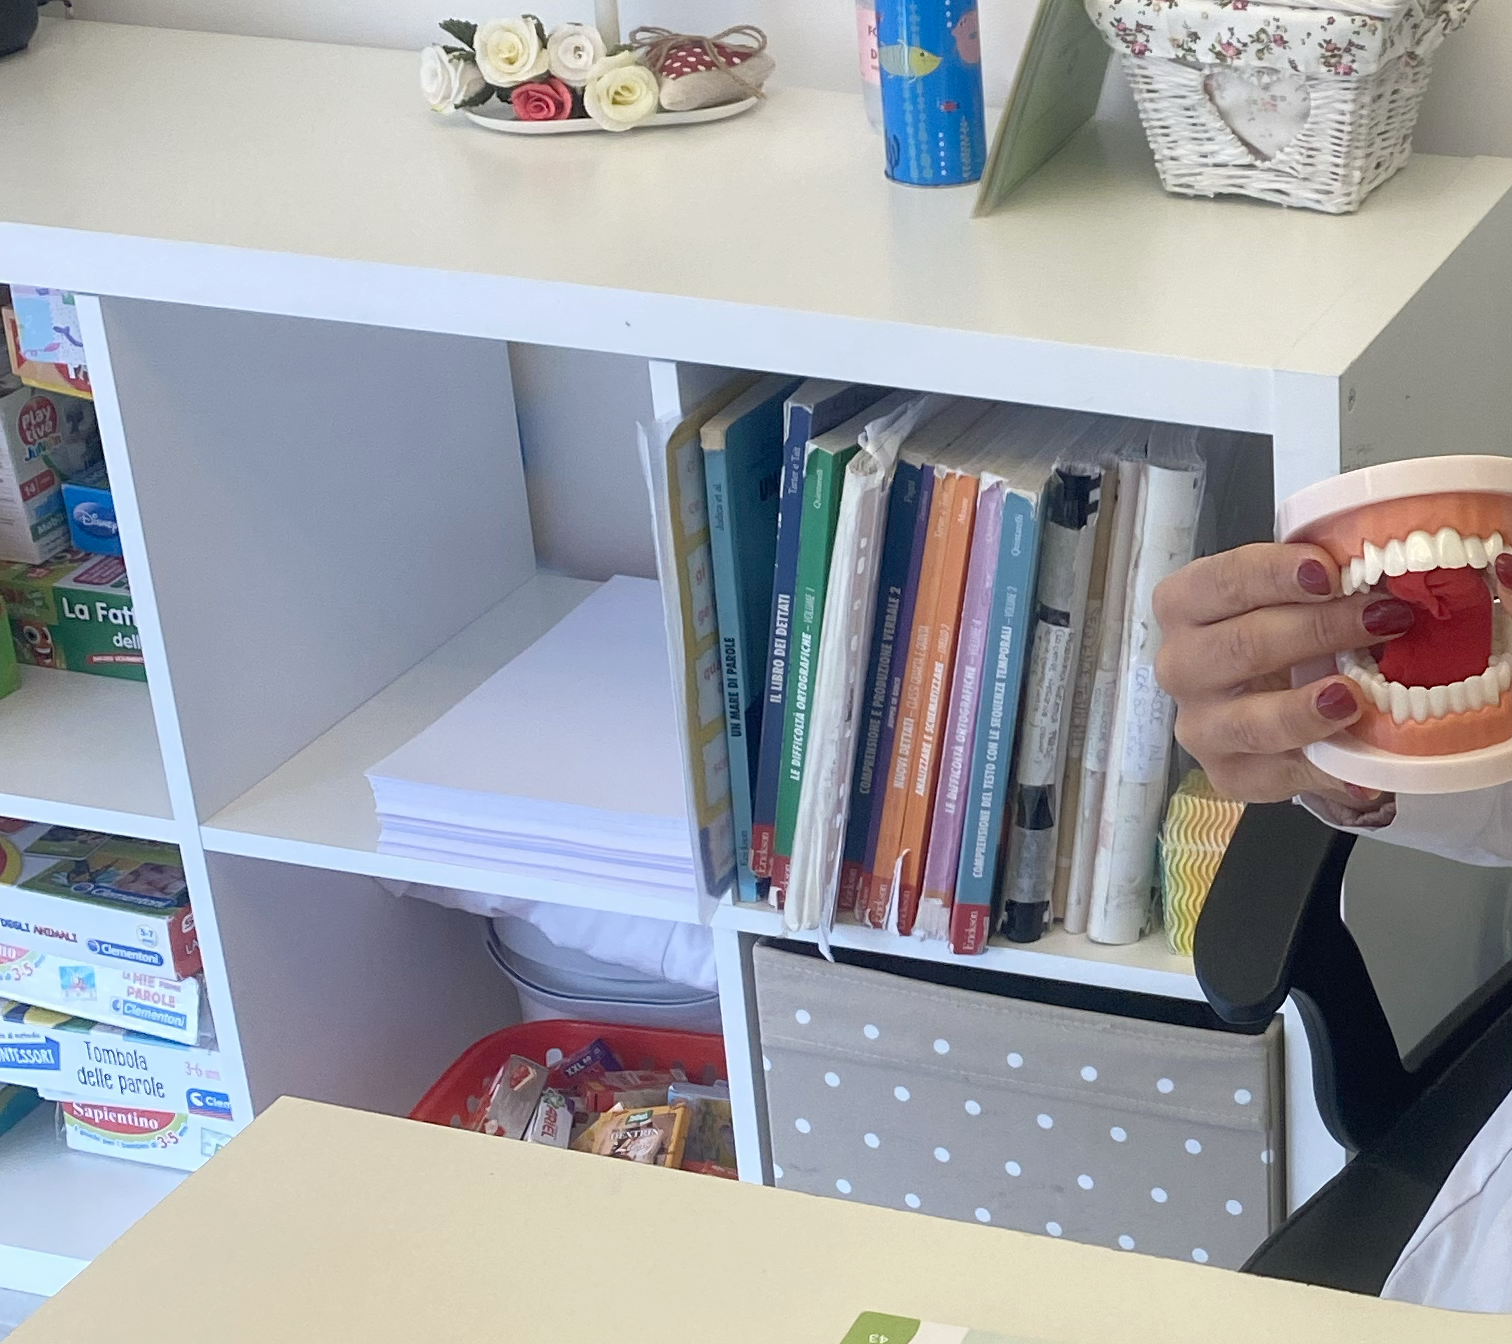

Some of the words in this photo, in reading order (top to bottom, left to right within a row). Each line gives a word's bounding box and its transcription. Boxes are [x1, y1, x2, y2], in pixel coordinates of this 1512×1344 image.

[22, 406, 51, 430] Play
[26, 420, 53, 445] tive
[889, 585, 901, 594] 2
[62, 597, 90, 621] La
[775, 593, 790, 636] DETTATI
[803, 593, 815, 623] VOLUME
[1003, 591, 1016, 617] VOLUME
[882, 596, 899, 641] VERBALE
[723, 637, 737, 675] PAROLE
[773, 638, 787, 656] DEI
[995, 625, 1012, 678] TEMPORALI
[726, 677, 738, 688] DI
[770, 658, 785, 690] LIBRO
[794, 631, 813, 709] ORTOGRAFICHE
[872, 643, 892, 707] PRODUZIONE
[727, 691, 740, 719] MARE
[769, 691, 782, 702] IL
[954, 664, 975, 743] ORTOGRAFICHE
[989, 681, 1006, 727] SEQUENZE
[729, 721, 741, 736] UN
[787, 712, 805, 766] DIFFICOLTÀ
[898, 716, 914, 755] DETTATI
[914, 741, 932, 796] ANALIZZARE
[924, 660, 945, 733] SCHEMATIZZARE
[988, 729, 1000, 740] LE
[859, 718, 881, 794] COMPRENSIONE
[985, 741, 999, 761] CON
[789, 769, 800, 780] LE
[893, 756, 908, 788] NUOVI
[944, 745, 964, 800] DIFFICOLTÀ
[982, 762, 996, 788] TESTO
[944, 801, 956, 813] LE
[980, 790, 993, 807] DEL
[755, 831, 769, 873] Erickson
[971, 809, 991, 878] COMPRENSIONE
[871, 882, 888, 923] Erickson
[897, 888, 911, 923] rickson
[962, 909, 978, 950] Erickson
[101, 944, 160, 964] Clementoni
[11, 962, 33, 982] 3-5
[133, 971, 155, 987] MIE
[127, 986, 176, 1008] PAROLE
[124, 1002, 185, 1028] Clementoni
[84, 1040, 149, 1071] Tombola
[184, 1061, 204, 1077] 3-6
[564, 1061, 586, 1077] XXL
[77, 1067, 114, 1090] delle
[118, 1073, 166, 1099] parole
[72, 1102, 159, 1131] Sapientino
[541, 1105, 558, 1139] ARIEL
[157, 1132, 179, 1149] 3-5
[867, 1332, 889, 1344] 43
